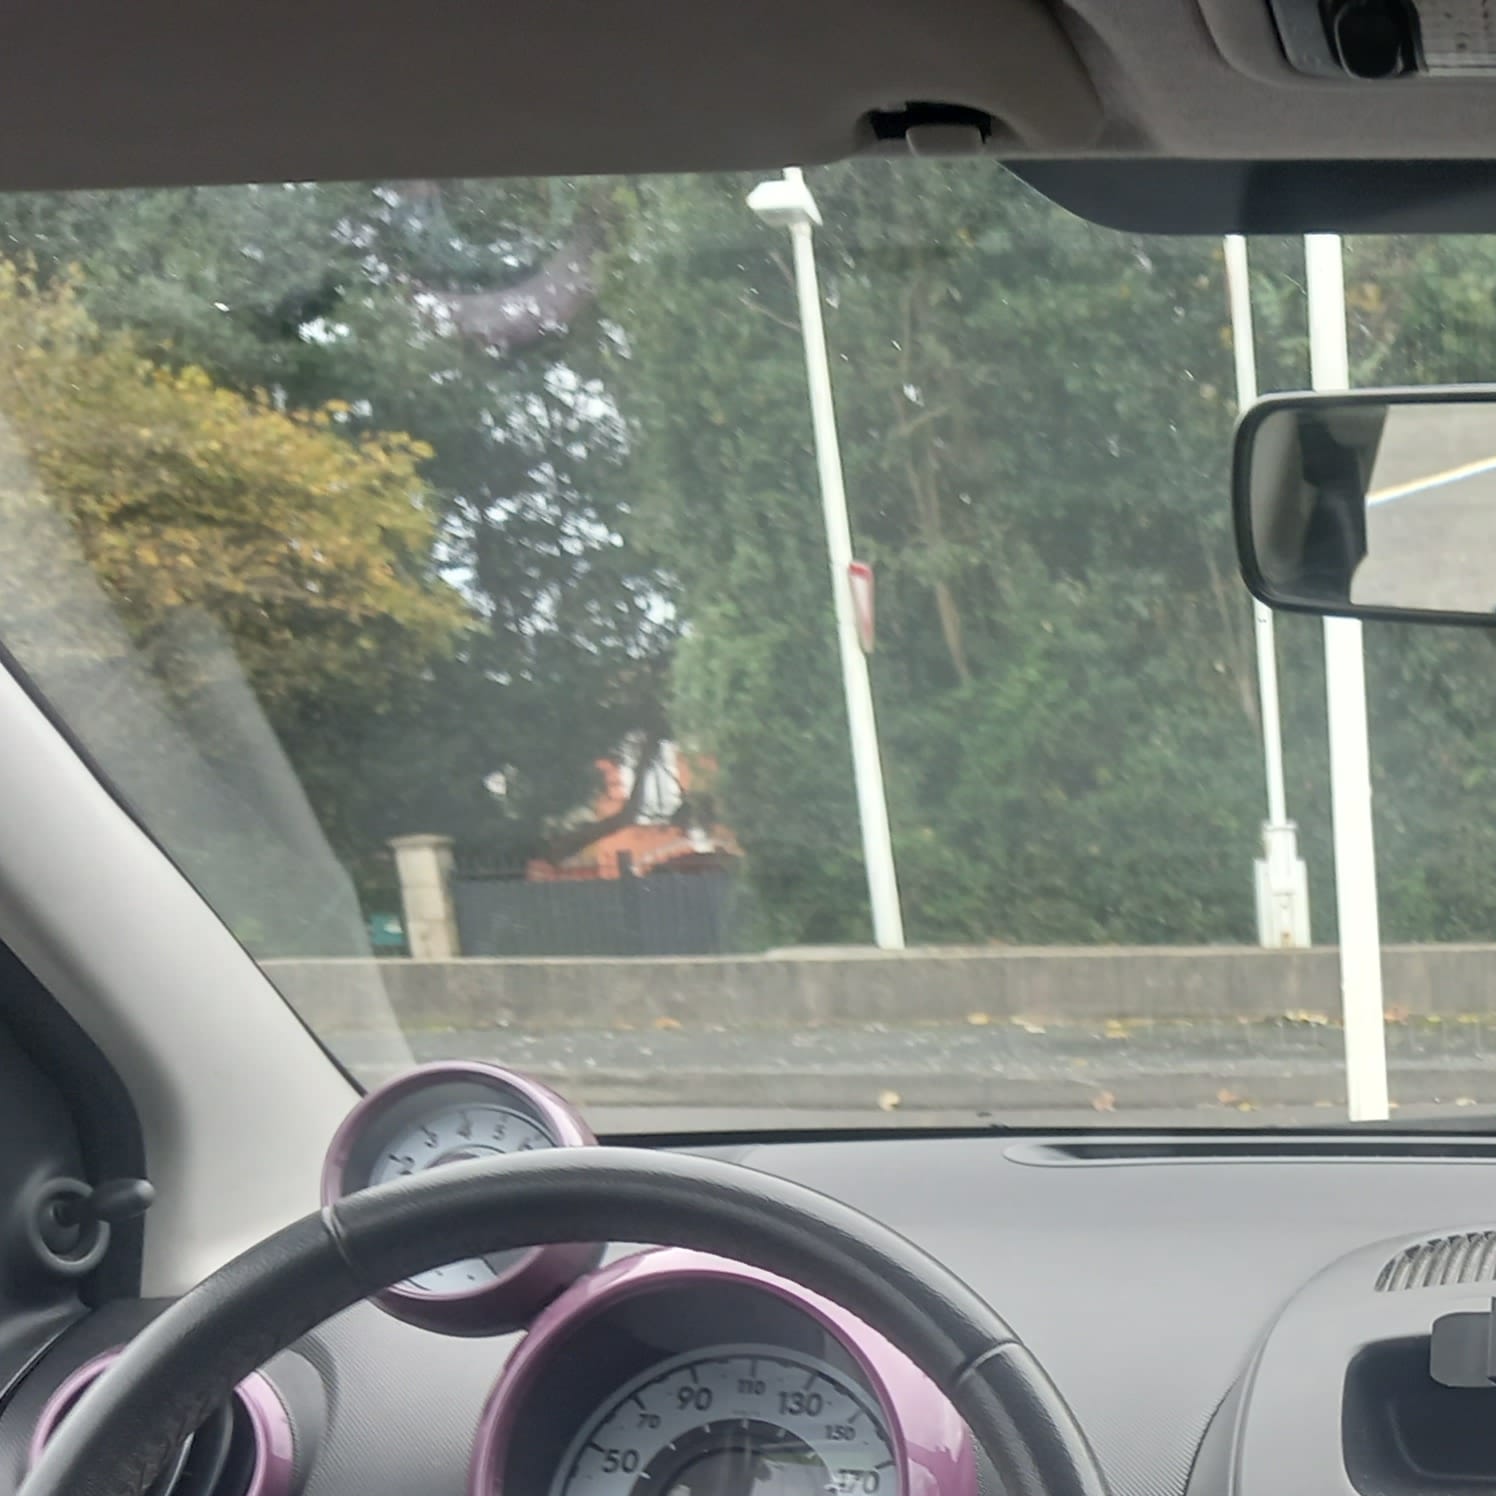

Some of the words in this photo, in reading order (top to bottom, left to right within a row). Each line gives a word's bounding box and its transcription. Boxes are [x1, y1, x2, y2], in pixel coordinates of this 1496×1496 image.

[737, 1379, 766, 1395] 110
[677, 1386, 713, 1411] 90
[778, 1391, 823, 1417] 130
[638, 1412, 662, 1429] 70
[825, 1424, 857, 1441] 150
[602, 1449, 640, 1474] 50
